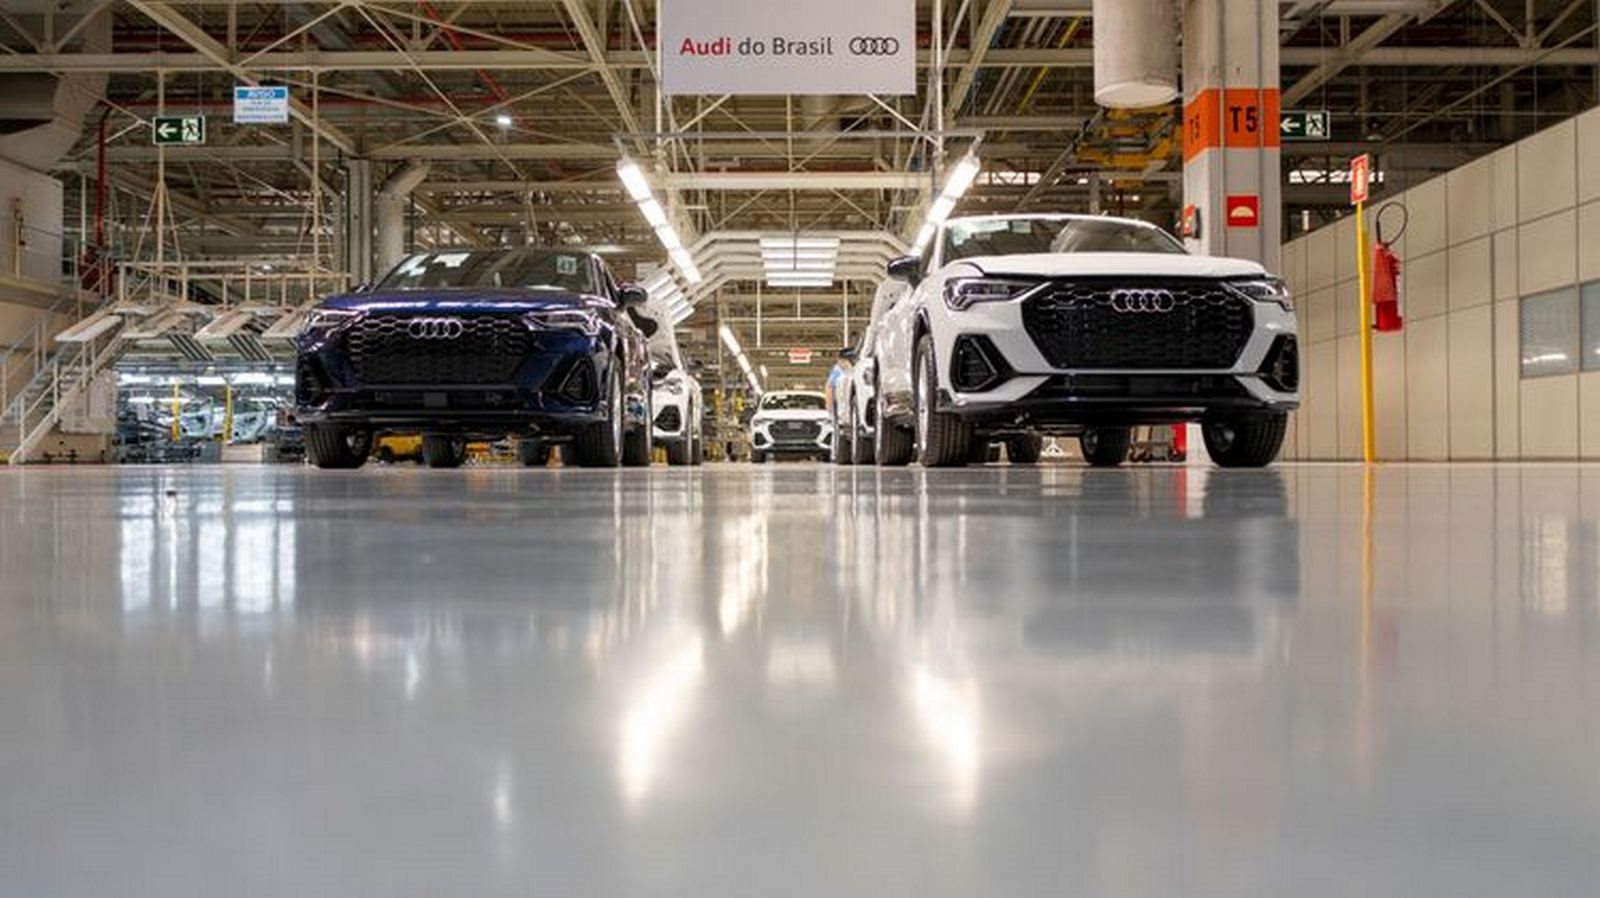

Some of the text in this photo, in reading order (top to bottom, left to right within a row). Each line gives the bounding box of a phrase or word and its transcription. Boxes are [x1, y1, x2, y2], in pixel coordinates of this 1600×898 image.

[680, 37, 833, 55] Audi do Brasil
[1229, 106, 1258, 133] T5
